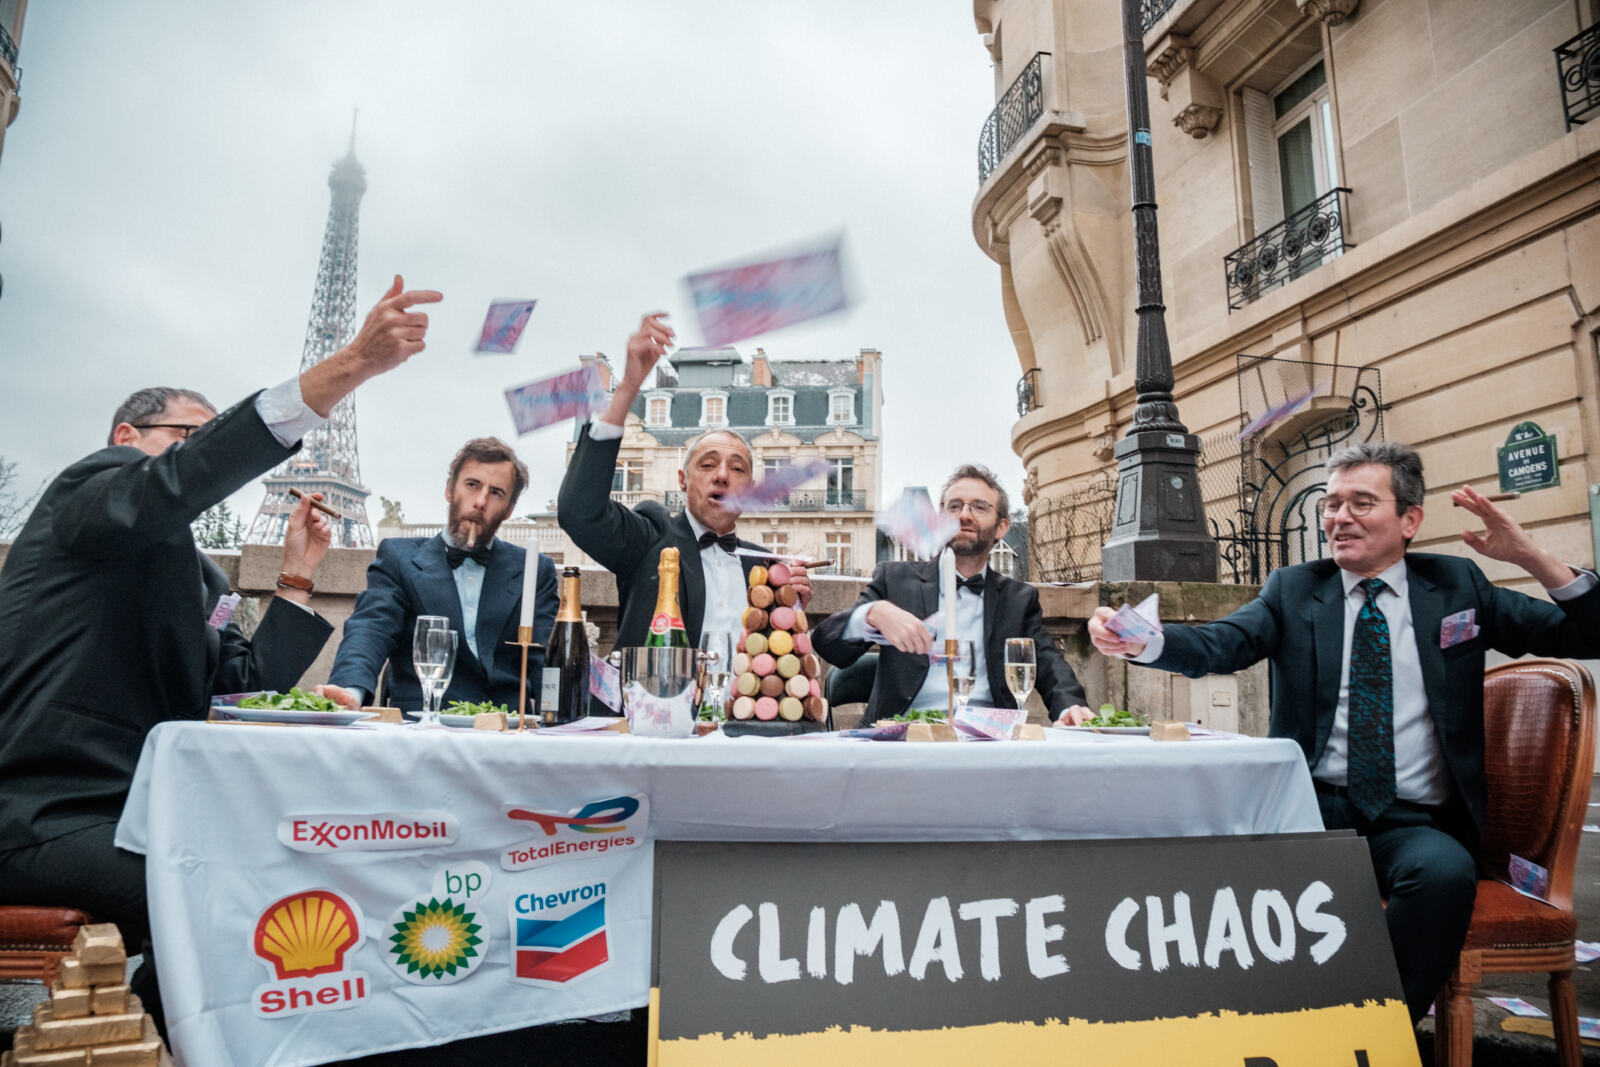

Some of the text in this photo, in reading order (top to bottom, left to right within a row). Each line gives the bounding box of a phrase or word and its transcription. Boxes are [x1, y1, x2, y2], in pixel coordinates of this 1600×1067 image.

[1508, 444, 1545, 461] AVENUE
[293, 820, 446, 848] ExxonMobil
[509, 835, 635, 865] TotalEnergies
[445, 869, 482, 897] bp
[515, 882, 607, 914] Chevron
[710, 881, 1347, 985] CLIMATE CHAOS
[260, 977, 365, 1013] Shell
